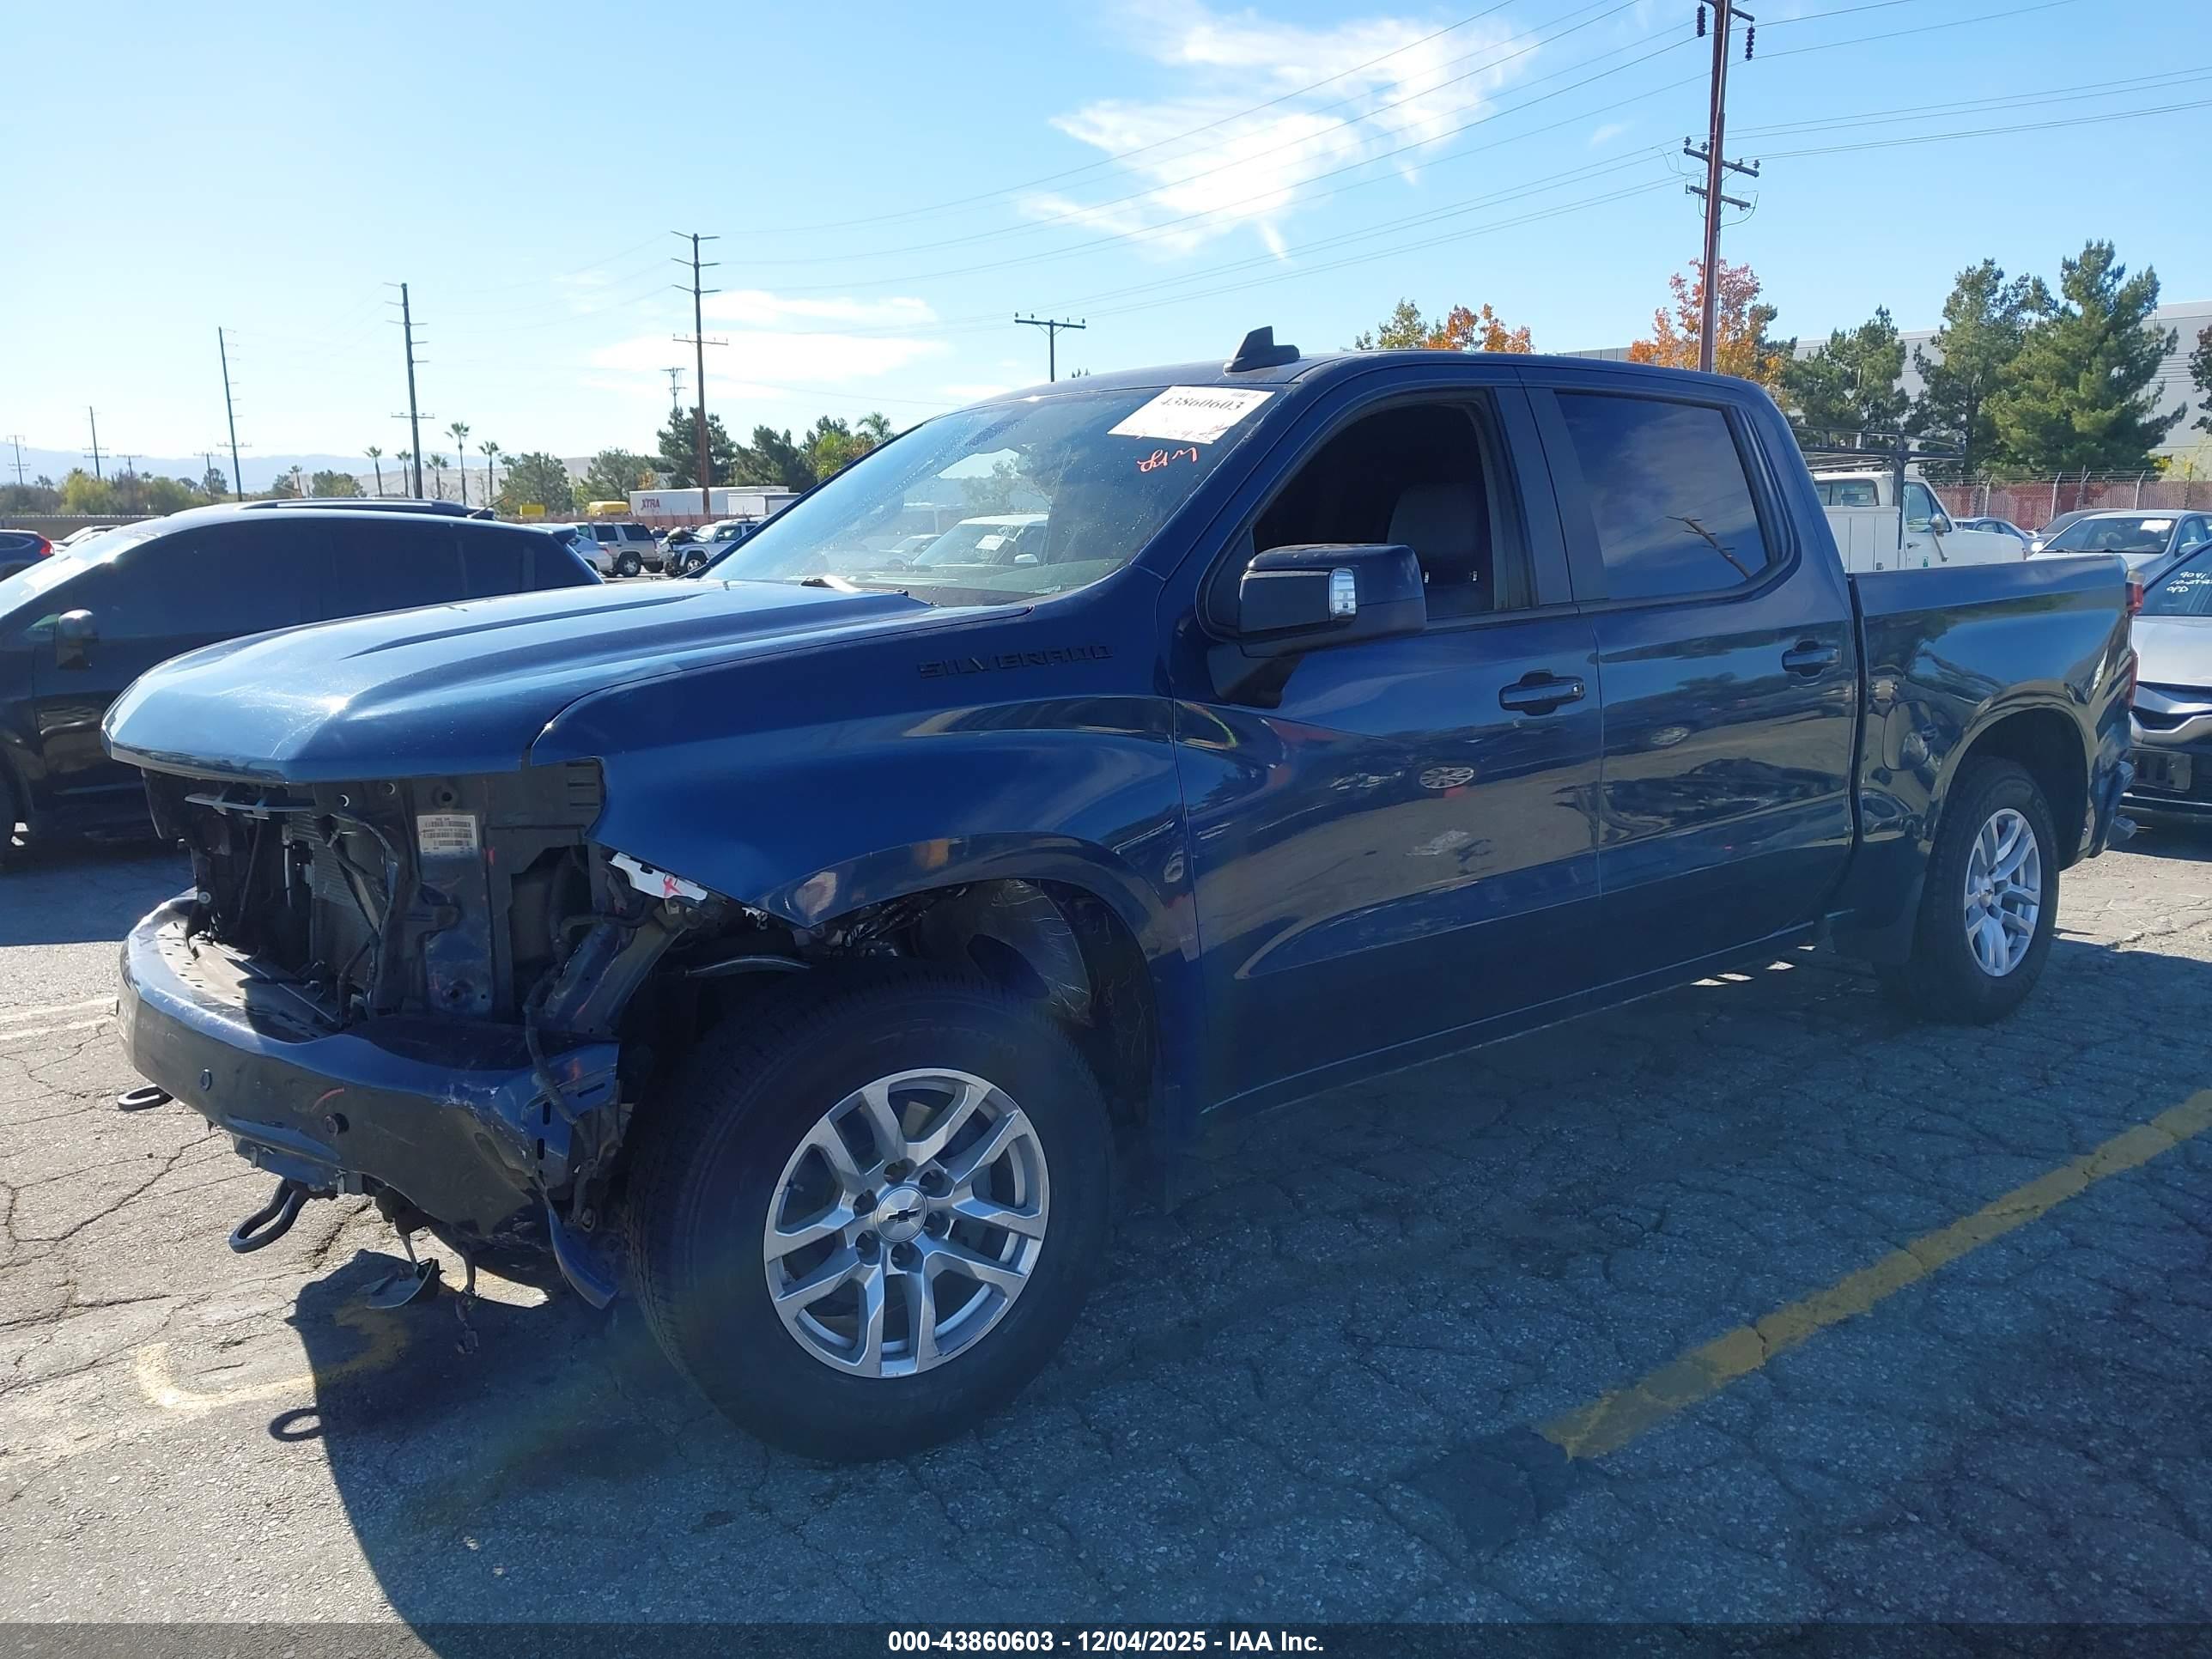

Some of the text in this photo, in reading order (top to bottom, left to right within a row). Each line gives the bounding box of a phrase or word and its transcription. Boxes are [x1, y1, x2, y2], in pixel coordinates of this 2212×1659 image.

[1160, 397, 1246, 411] 43860603
[641, 498, 660, 511] XTRA
[918, 645, 1115, 680] SILVERADO
